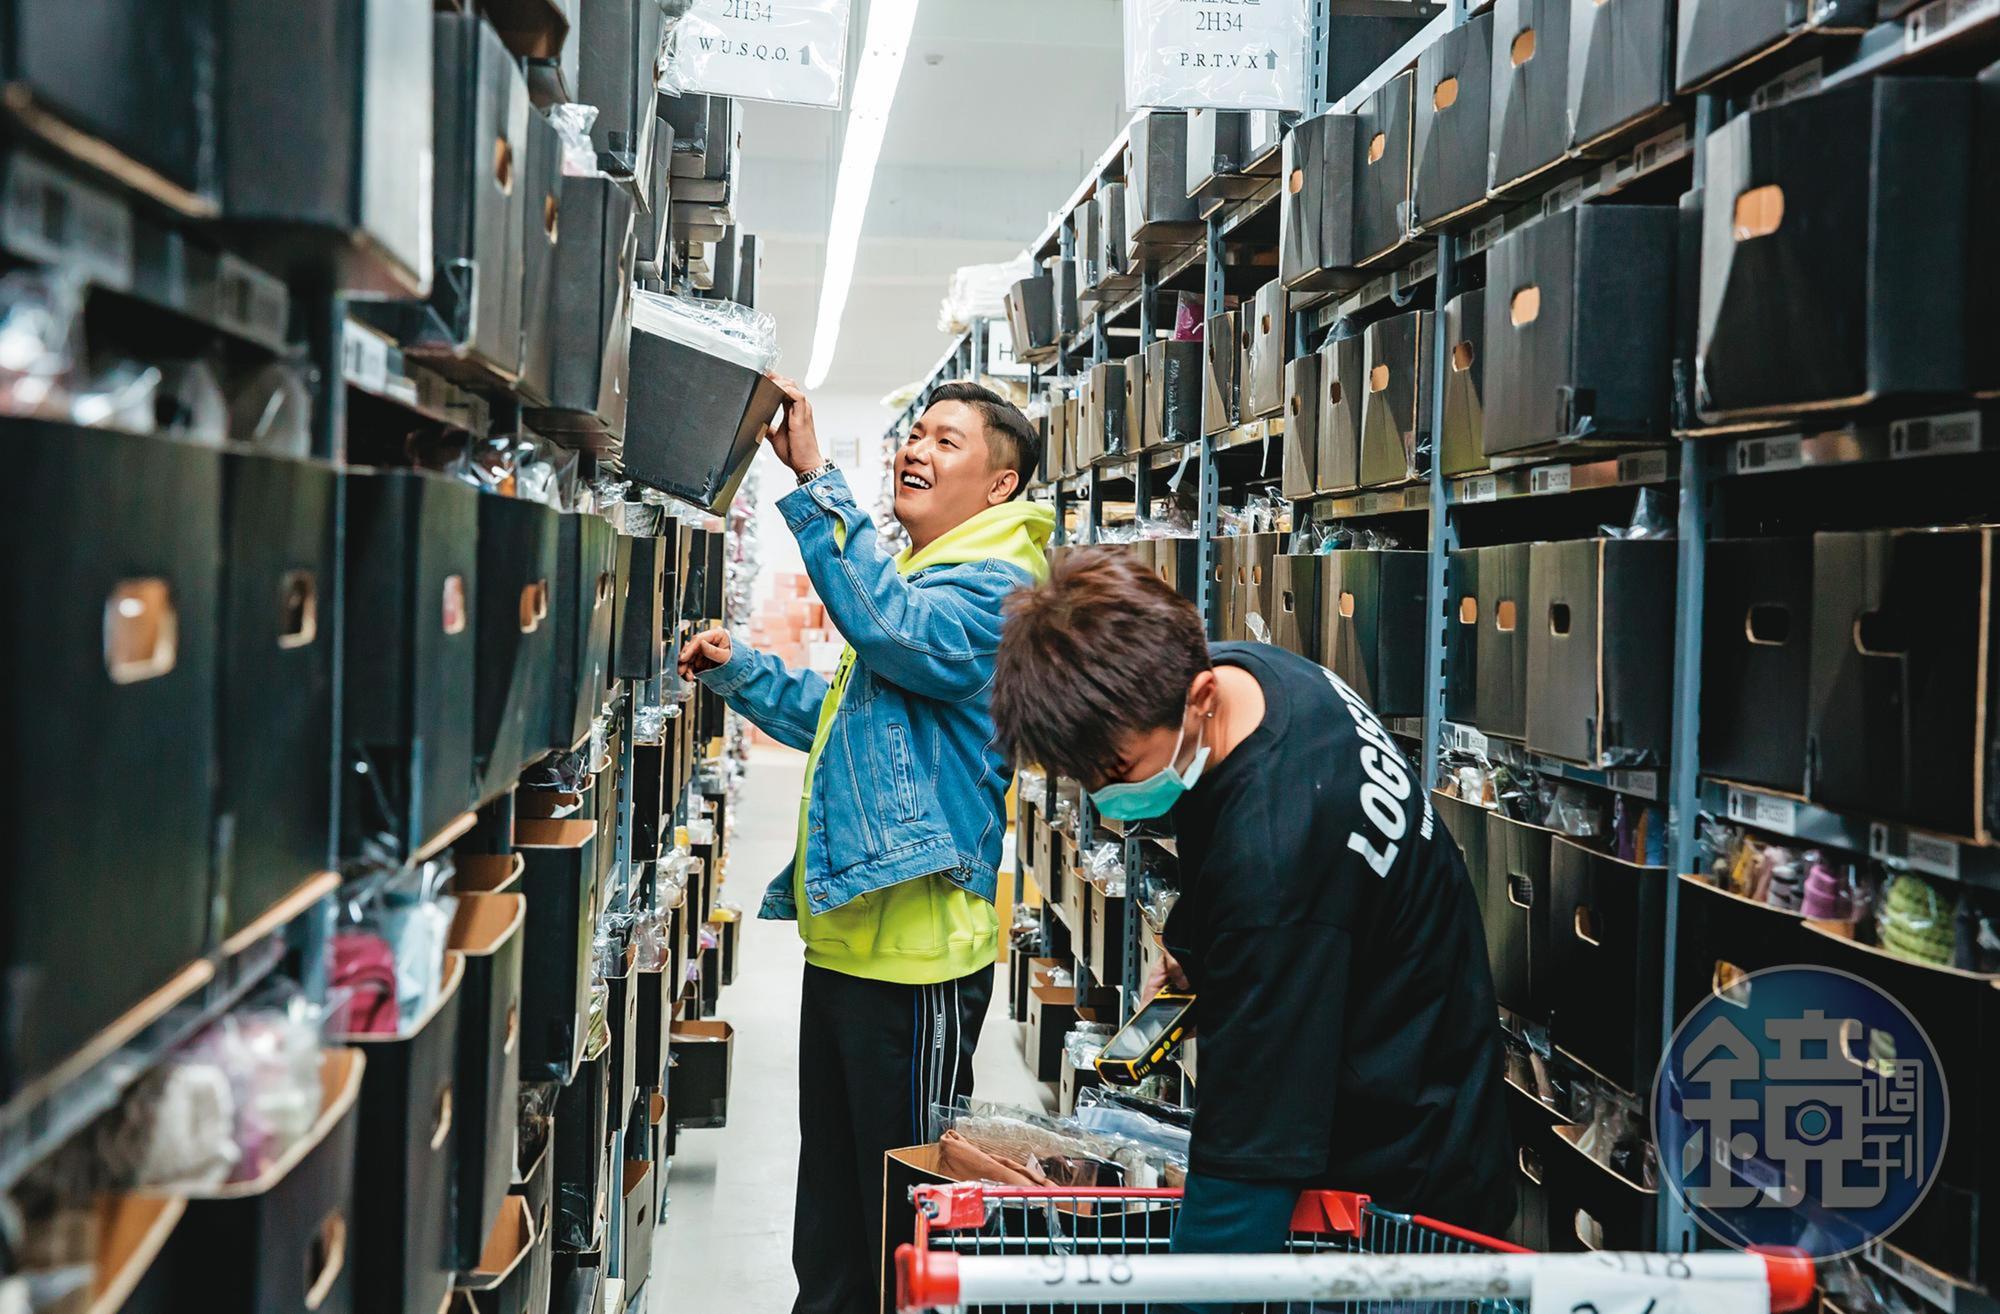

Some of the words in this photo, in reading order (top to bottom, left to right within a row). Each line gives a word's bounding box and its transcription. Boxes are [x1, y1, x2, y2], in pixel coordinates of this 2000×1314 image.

[722, 0, 773, 23] 2H34
[1196, 10, 1243, 32] 2H34
[1042, 1253, 1133, 1286] 918
